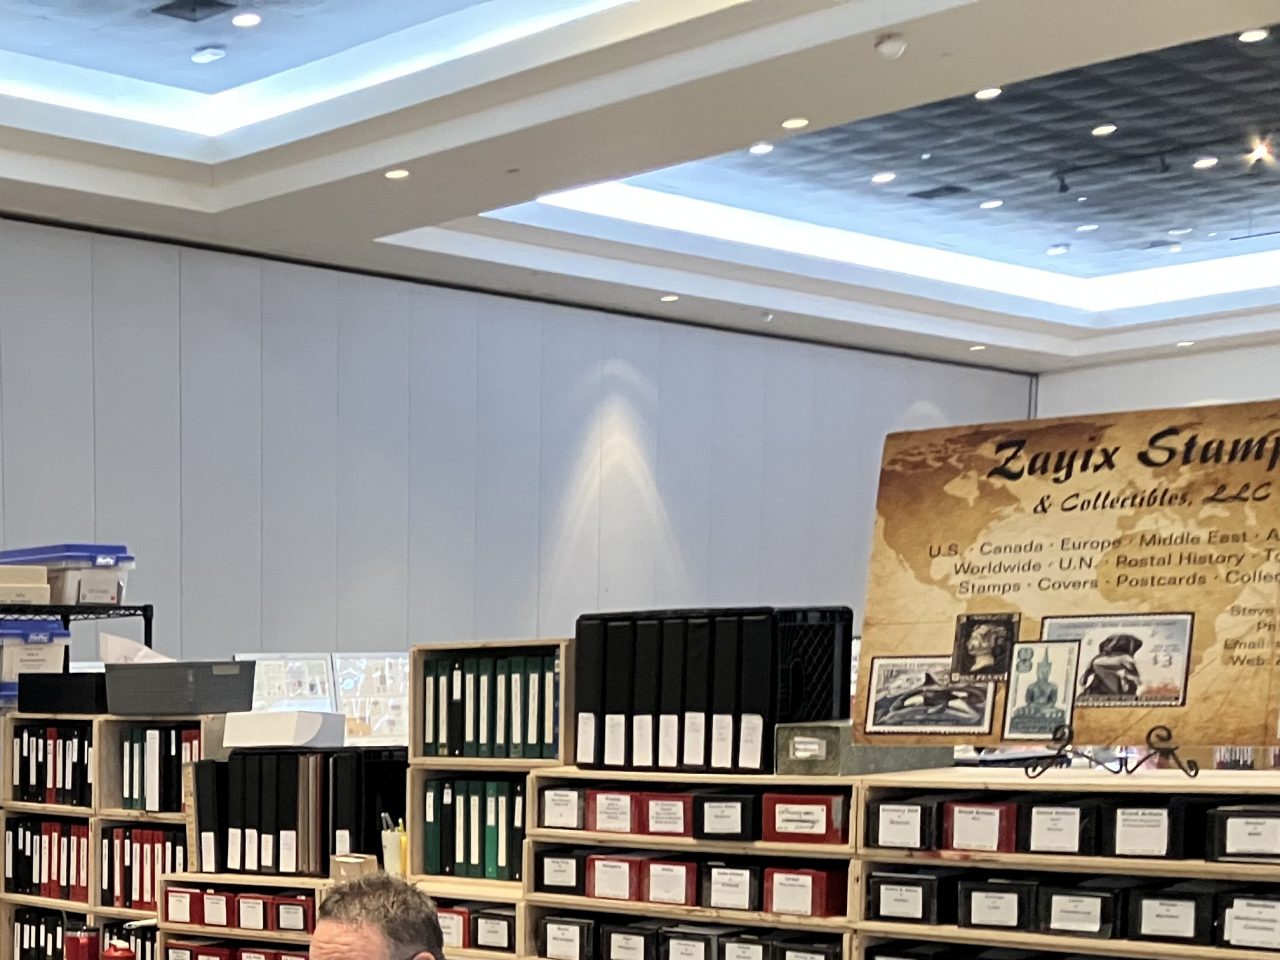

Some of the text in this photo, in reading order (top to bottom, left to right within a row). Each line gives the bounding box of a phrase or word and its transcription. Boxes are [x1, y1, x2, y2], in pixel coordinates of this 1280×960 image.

[987, 436, 1122, 484] Zayix
[1033, 482, 1271, 514] & Collectibles, LLC
[979, 540, 1043, 555] Canada
[1060, 537, 1121, 553] Europe
[1139, 530, 1200, 546] Middle
[1207, 531, 1248, 544] East
[953, 560, 1041, 577] Worldwide
[1116, 552, 1173, 568] Postal
[1179, 552, 1245, 567] History
[958, 570, 1280, 596] Stamps Covers Postcards Collec
